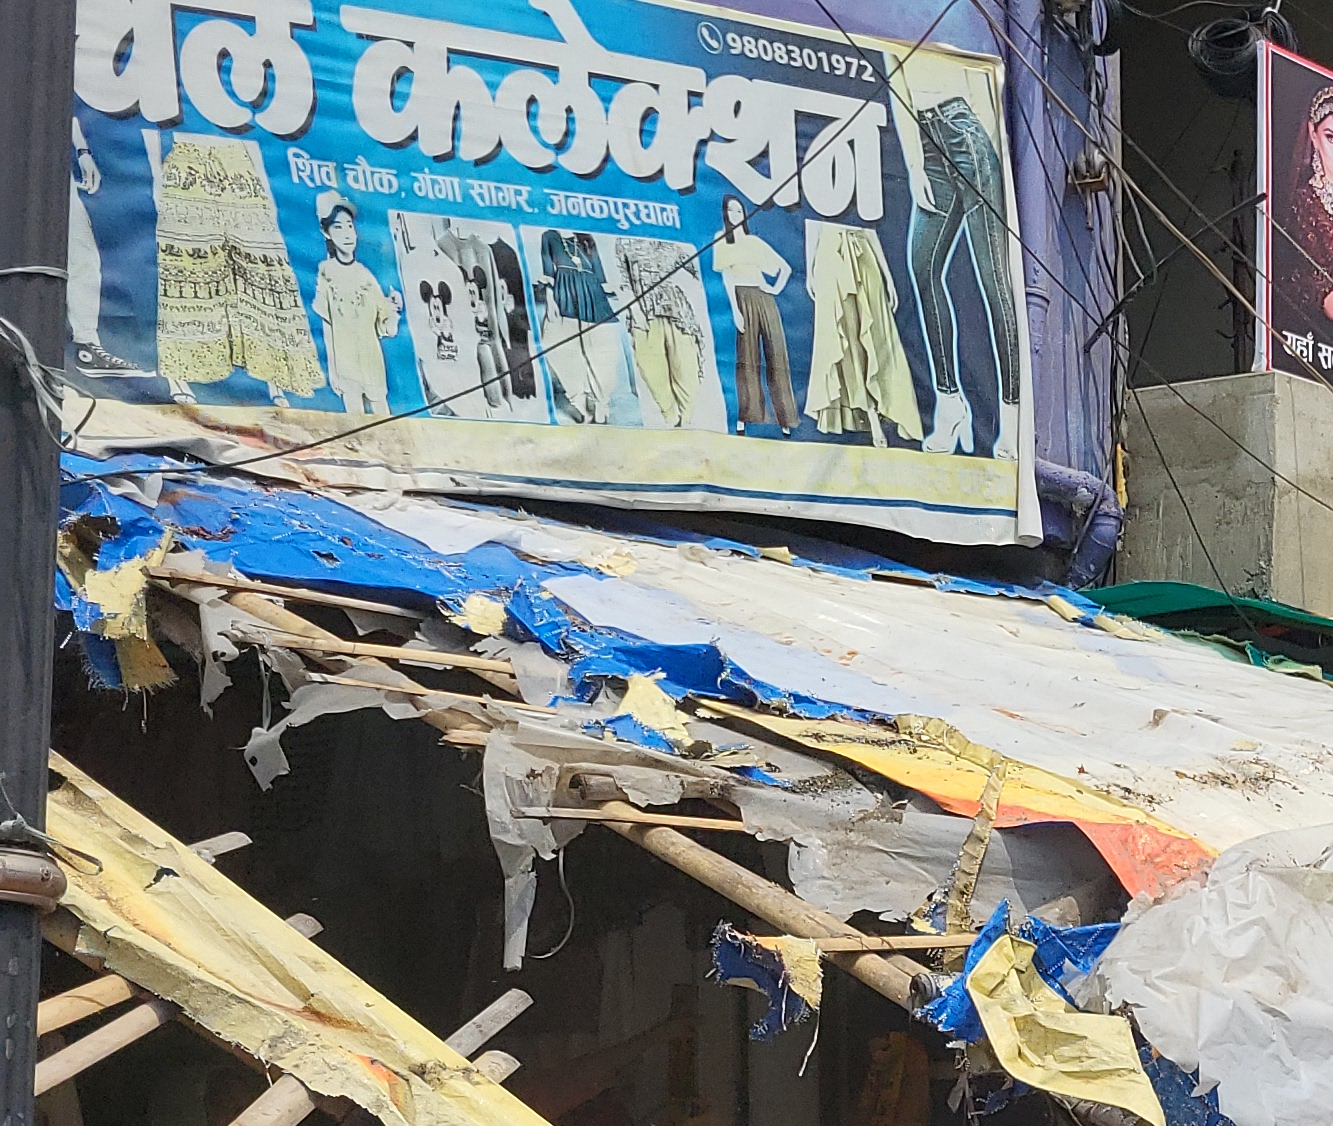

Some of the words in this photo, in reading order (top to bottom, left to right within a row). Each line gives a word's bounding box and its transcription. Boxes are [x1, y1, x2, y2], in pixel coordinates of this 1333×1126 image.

[726, 33, 876, 83] 9808301972
[340, 0, 887, 221] कलेक्शन
[287, 147, 338, 188] शिव
[410, 167, 463, 203] गंगा
[1282, 331, 1314, 362] यहाँ
